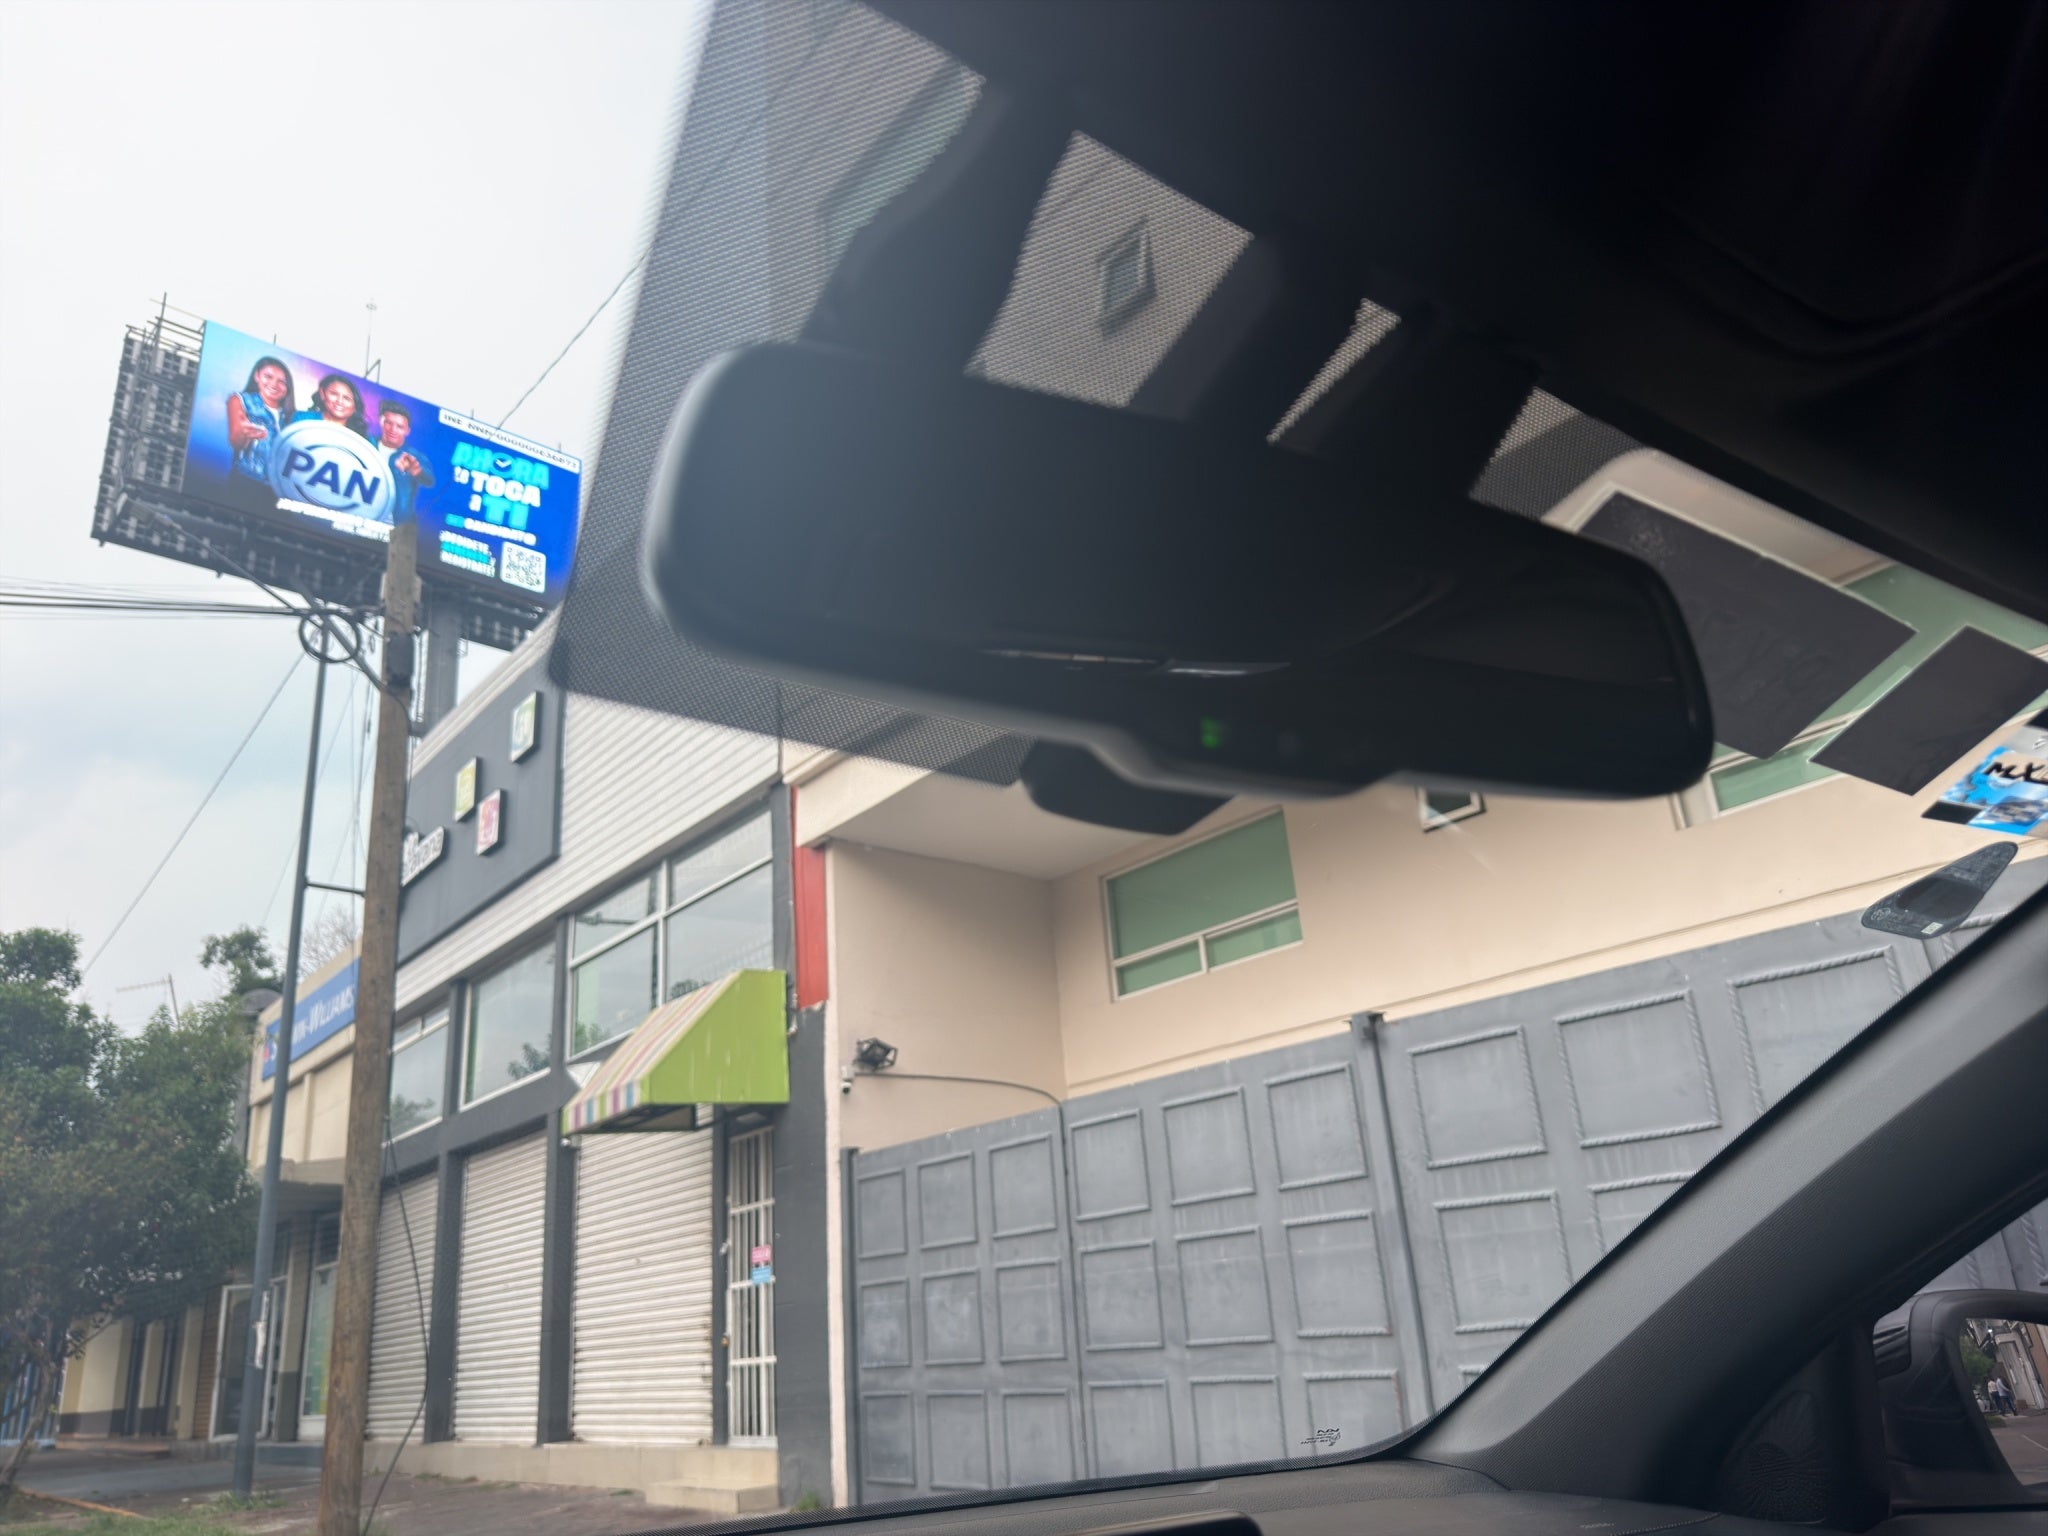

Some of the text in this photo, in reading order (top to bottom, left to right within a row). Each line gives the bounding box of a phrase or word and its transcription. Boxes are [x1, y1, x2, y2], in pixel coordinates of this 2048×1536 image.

[281, 447, 381, 505] PAN
[451, 441, 549, 490] AHORA
[471, 469, 541, 508] TOCA
[482, 493, 529, 530] TI
